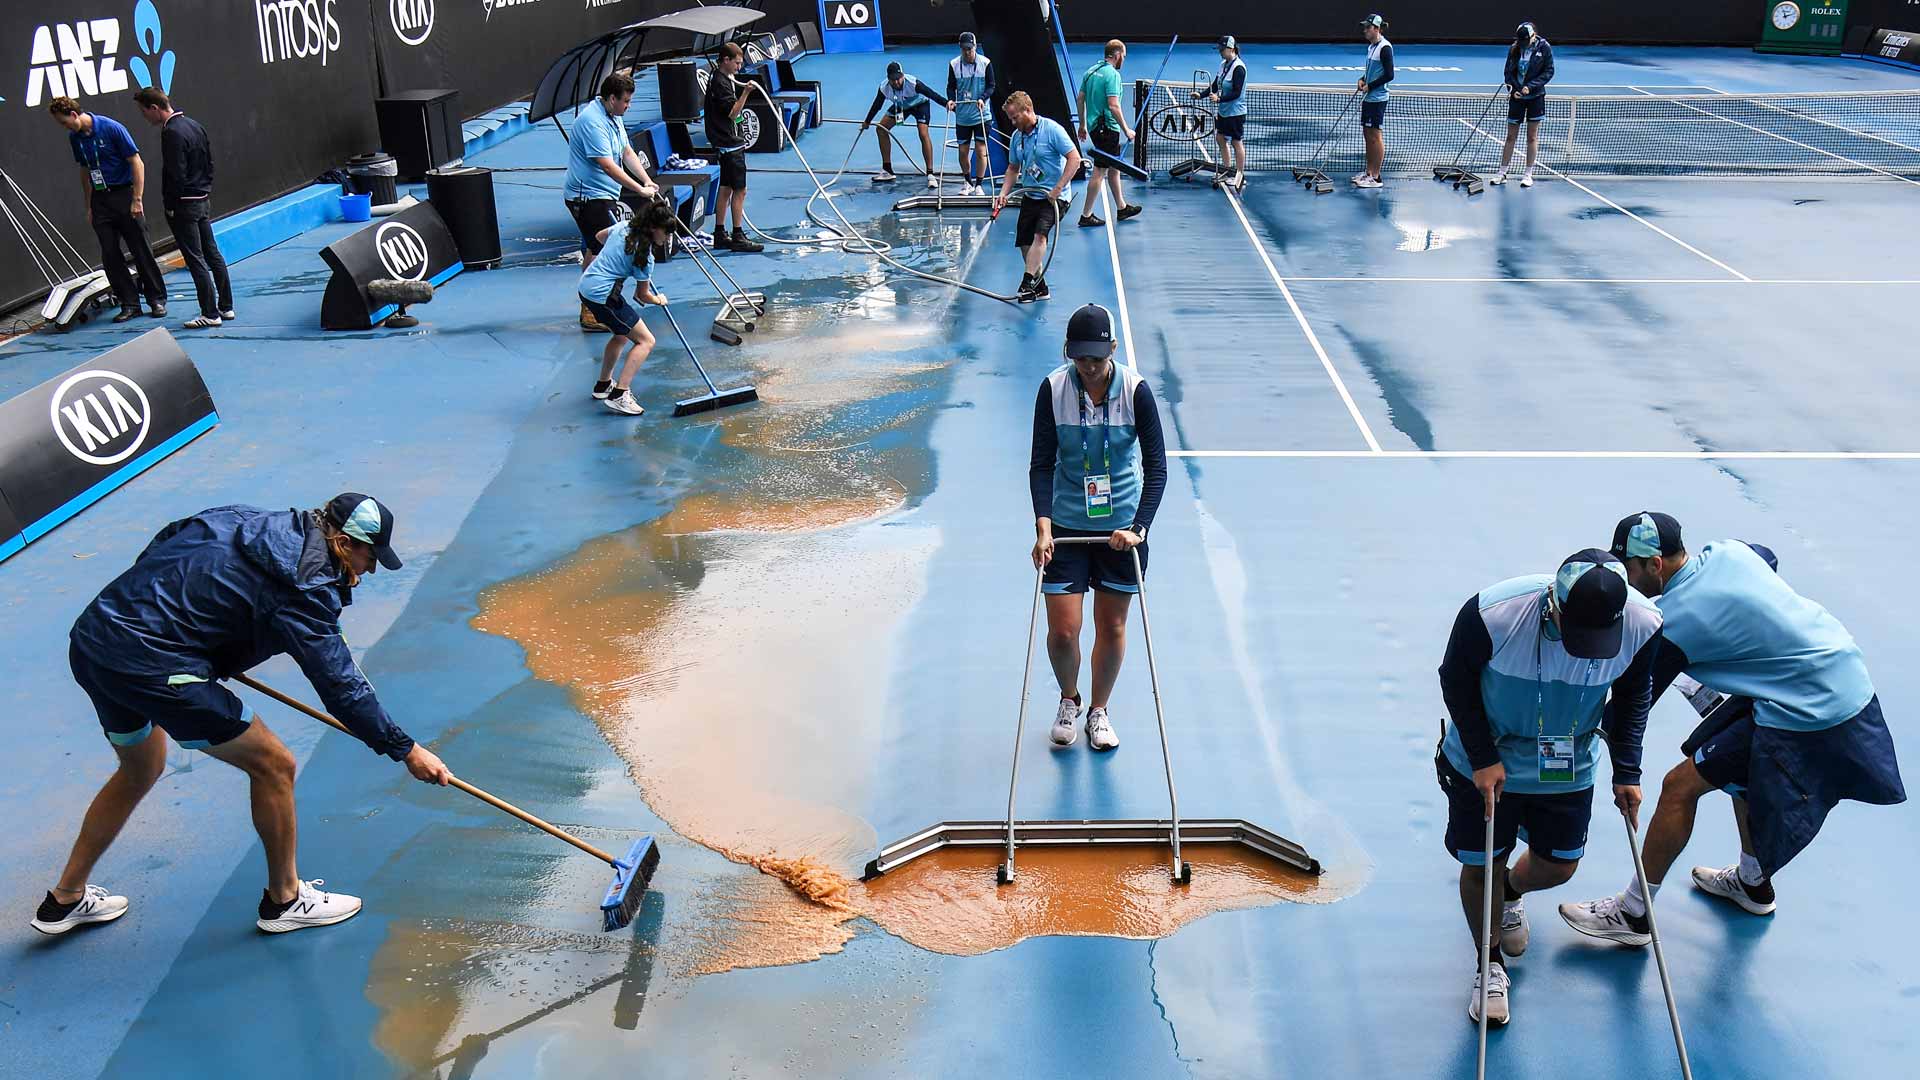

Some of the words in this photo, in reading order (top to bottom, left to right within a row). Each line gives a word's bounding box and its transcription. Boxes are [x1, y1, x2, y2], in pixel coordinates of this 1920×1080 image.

[398, 0, 430, 30] KIA
[834, 3, 869, 25] AO
[1811, 7, 1841, 16] ROLEX
[26, 17, 129, 108] ANZ
[381, 231, 424, 275] KIA
[60, 383, 143, 452] KIA
